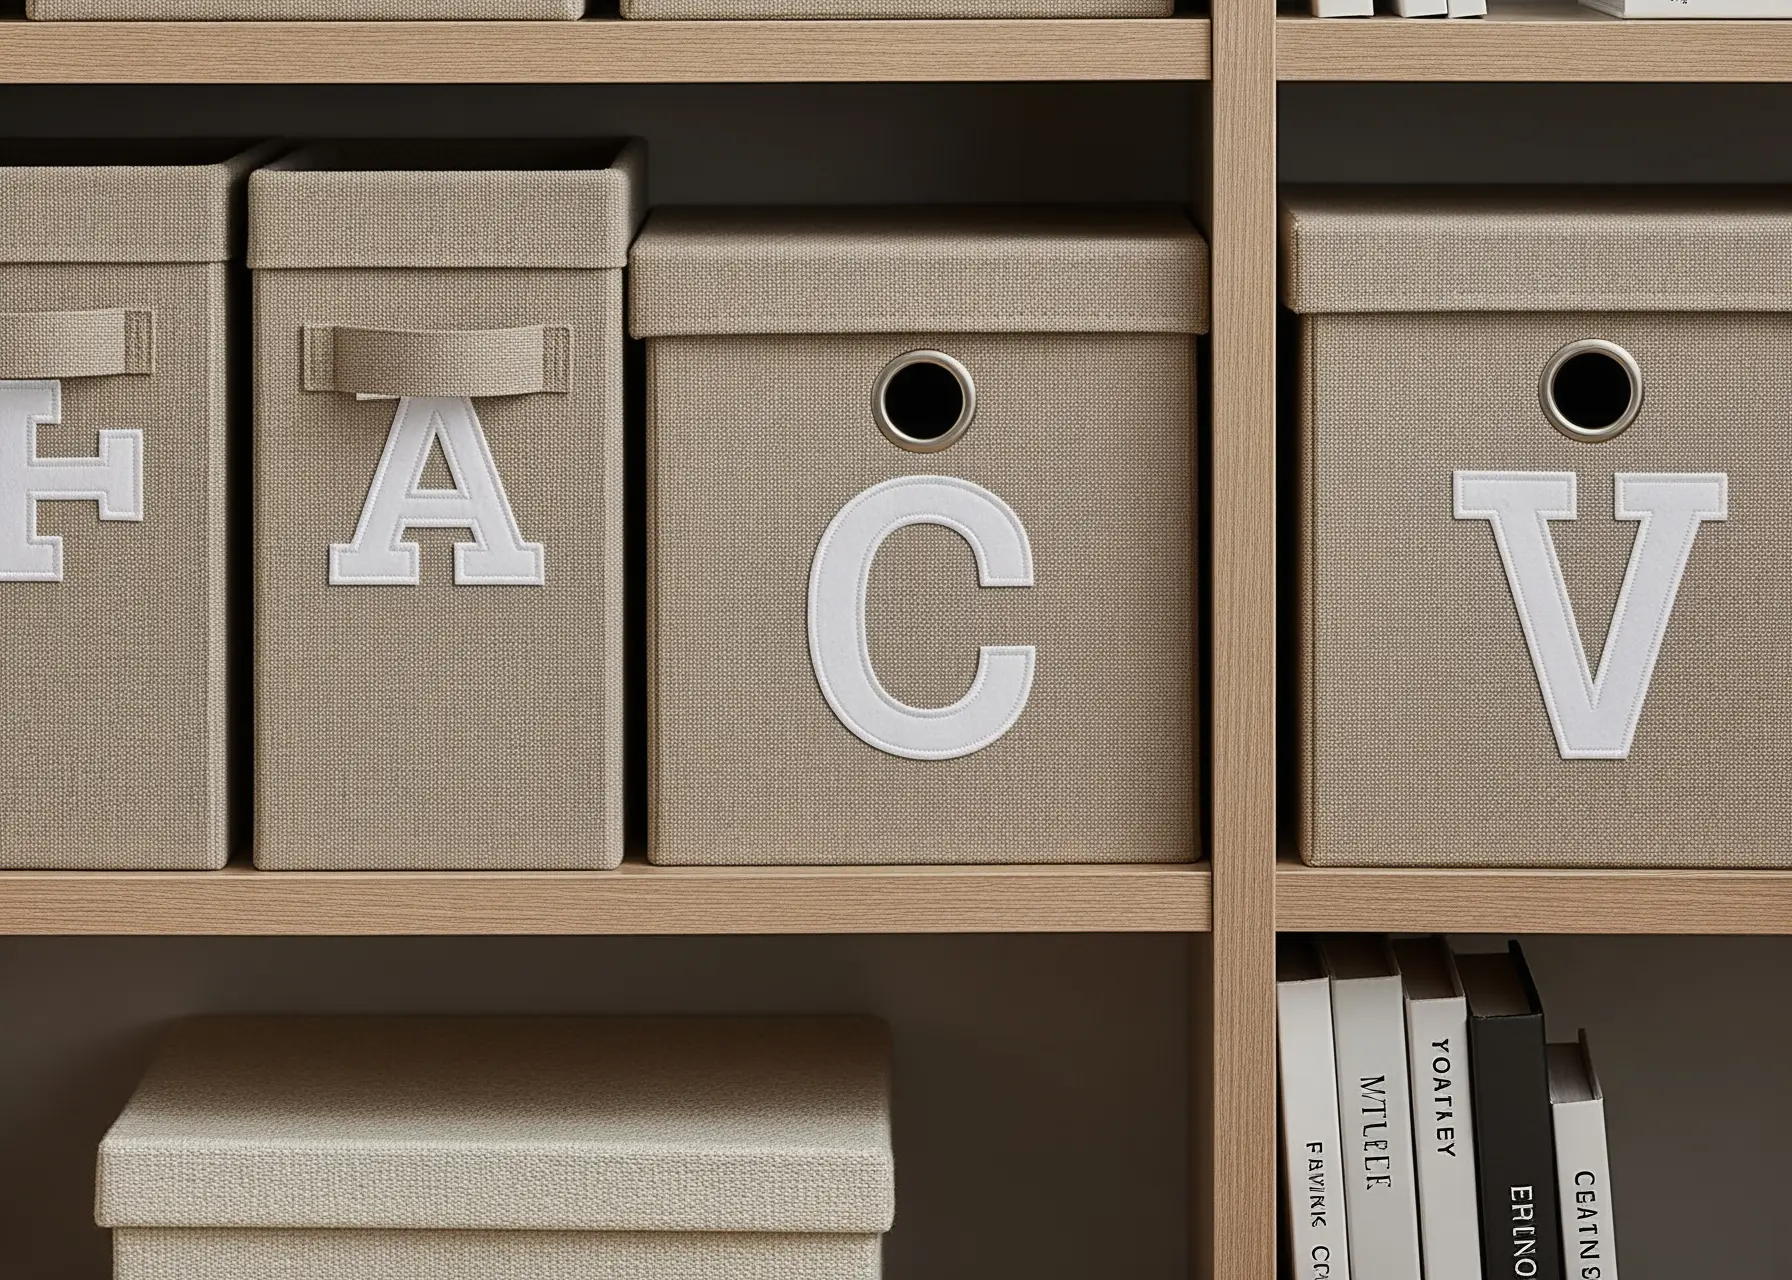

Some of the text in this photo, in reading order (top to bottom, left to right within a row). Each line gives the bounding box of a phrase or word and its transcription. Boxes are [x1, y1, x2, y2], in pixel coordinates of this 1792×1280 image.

[329, 396, 545, 585] A
[807, 476, 1038, 761] C
[1452, 470, 1730, 760] V
